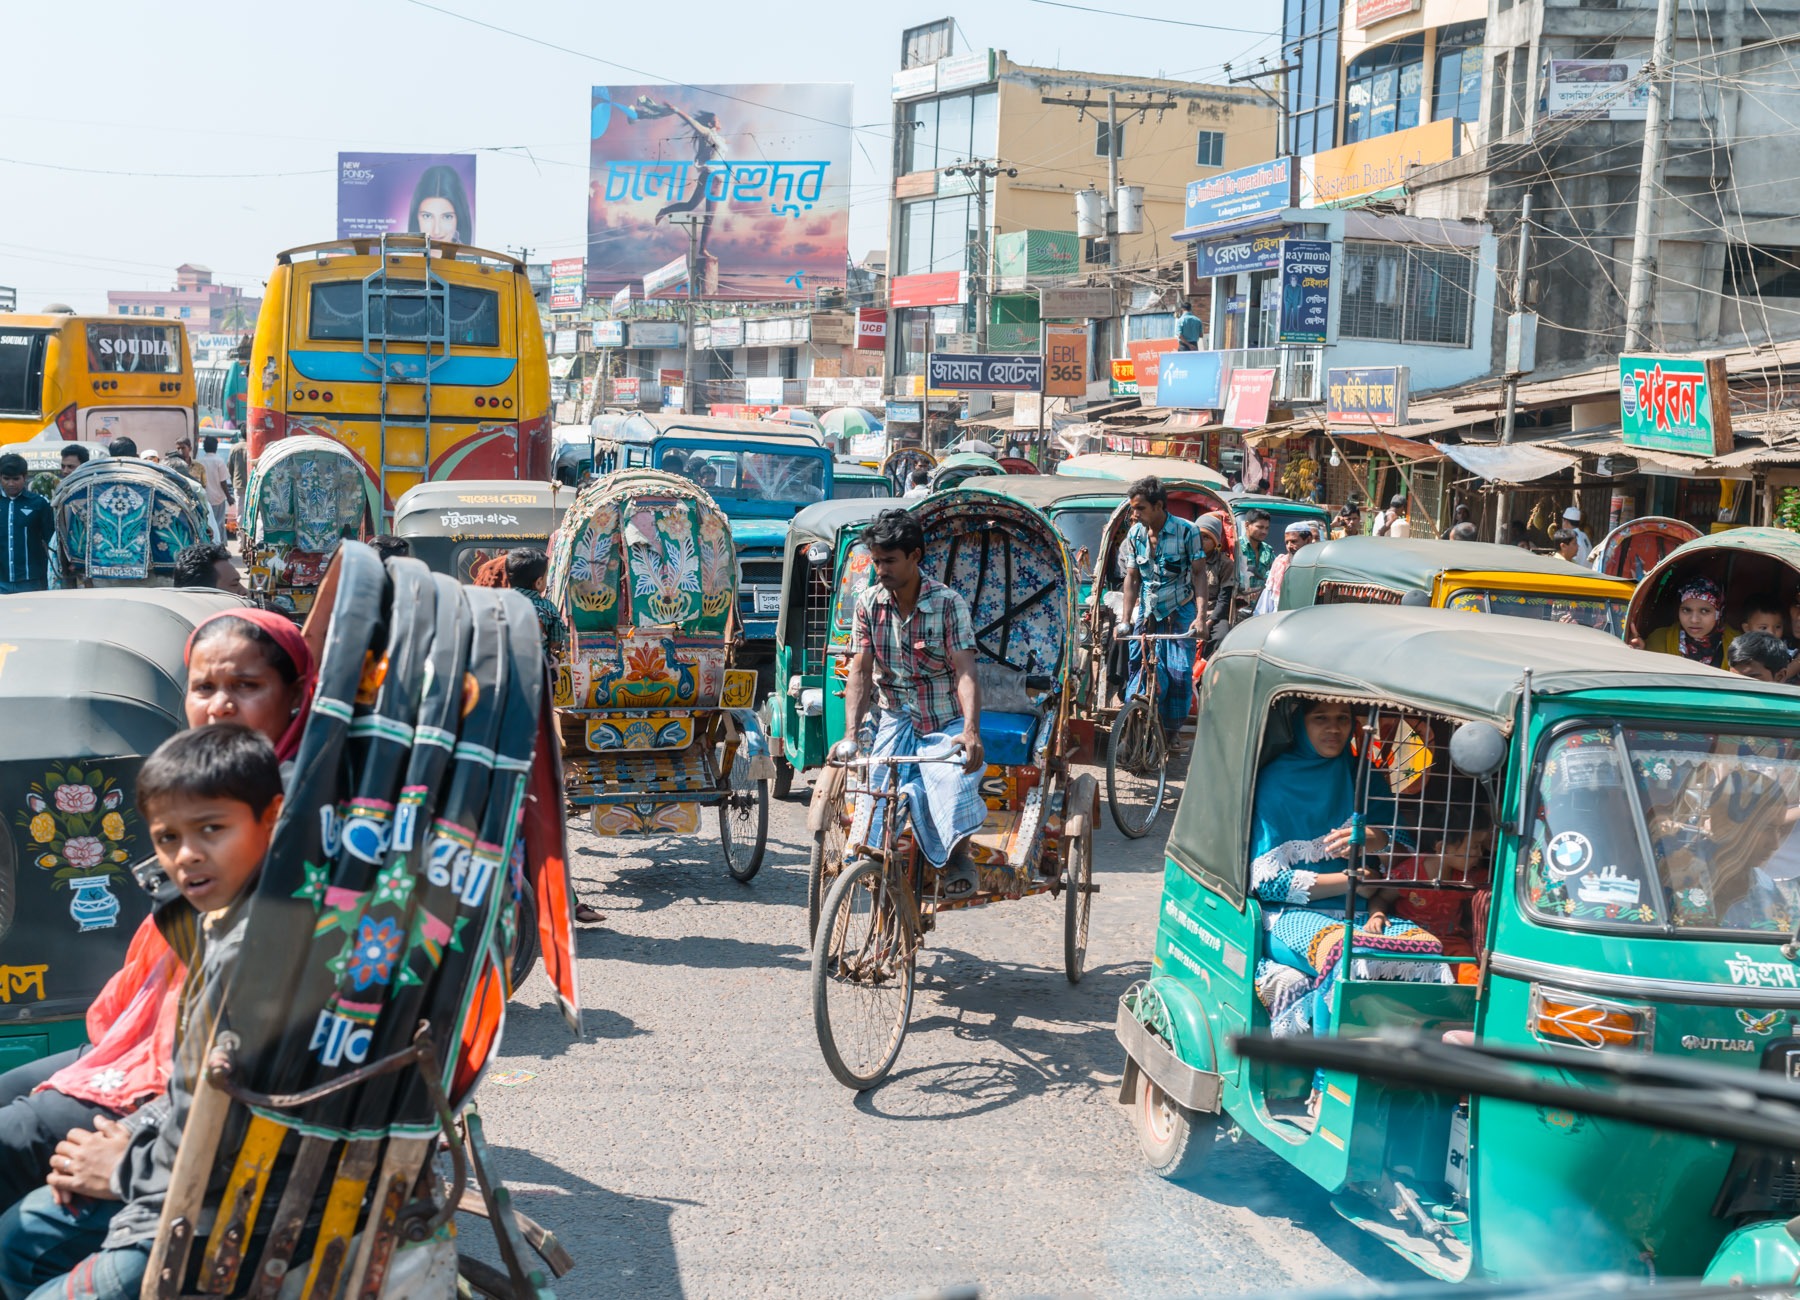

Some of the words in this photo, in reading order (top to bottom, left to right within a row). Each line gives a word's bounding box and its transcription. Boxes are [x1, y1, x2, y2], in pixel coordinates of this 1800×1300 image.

[343, 161, 360, 169] NEW
[343, 169, 371, 179] POND'S
[605, 160, 697, 202] চলো
[1315, 172, 1360, 198] Eastern
[1363, 158, 1395, 187] Bank
[1214, 242, 1252, 265] রেমন্ড
[1286, 263, 1328, 275] রেমন্ড
[861, 324, 882, 333] UCB
[0, 335, 28, 346] SOUDIA
[100, 338, 173, 356] SOUDIA
[1052, 345, 1080, 363] EBL
[932, 360, 983, 382] জামান
[988, 357, 1041, 384] হোটেল
[1050, 365, 1083, 381] 365
[1634, 362, 1705, 433] মধুবন
[1700, 1037, 1755, 1052] UTTARA
